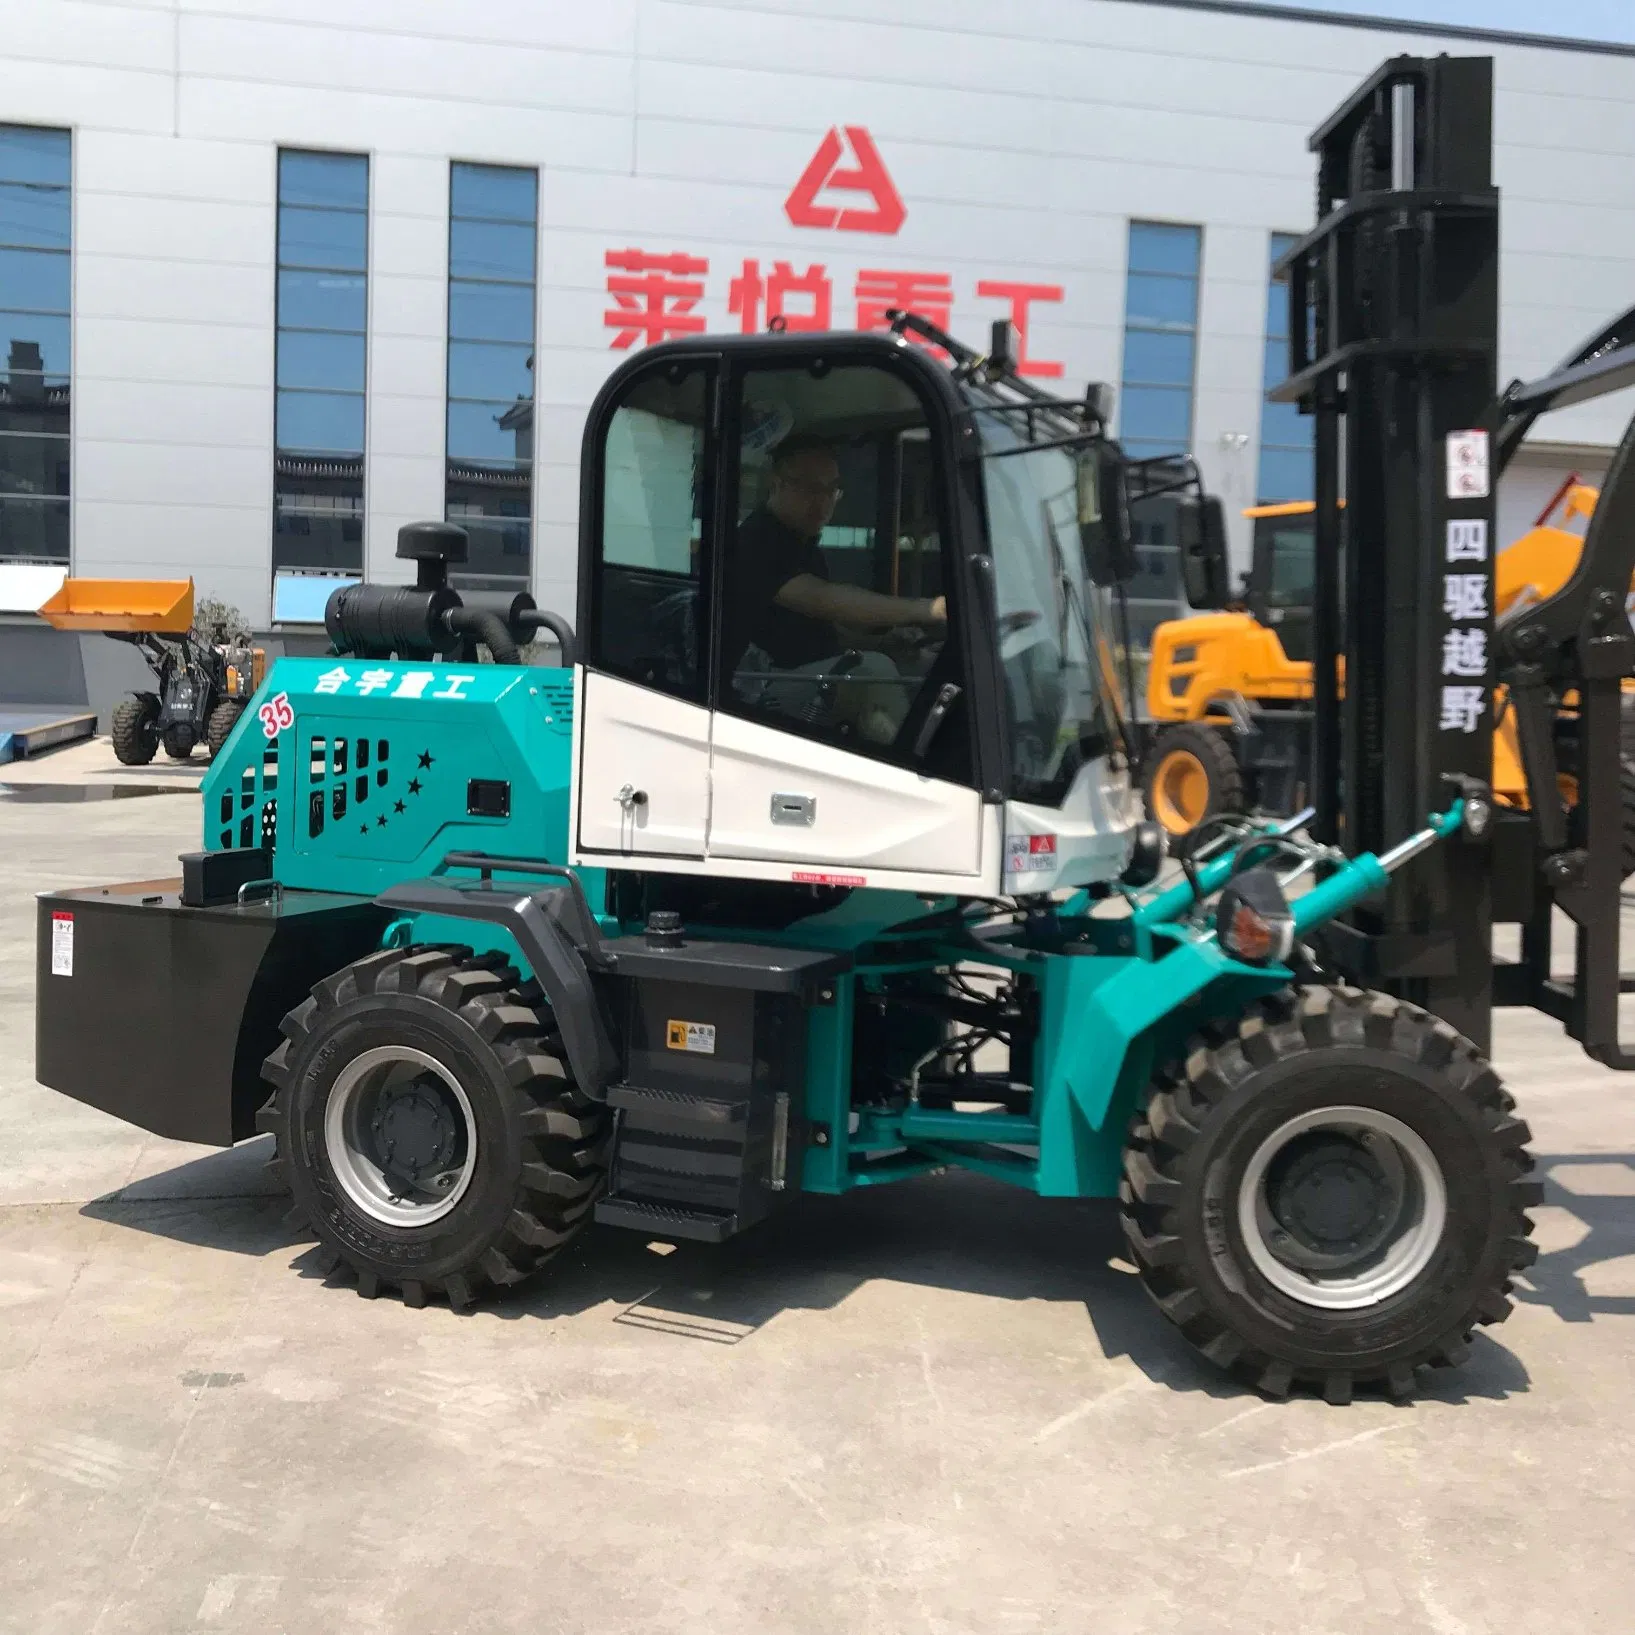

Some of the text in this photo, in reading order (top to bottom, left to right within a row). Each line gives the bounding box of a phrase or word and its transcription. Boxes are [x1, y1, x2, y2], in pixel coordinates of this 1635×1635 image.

[1440, 519, 1488, 733] 四驱越野
[313, 666, 476, 699] 合宇重工
[260, 693, 293, 738] 35
